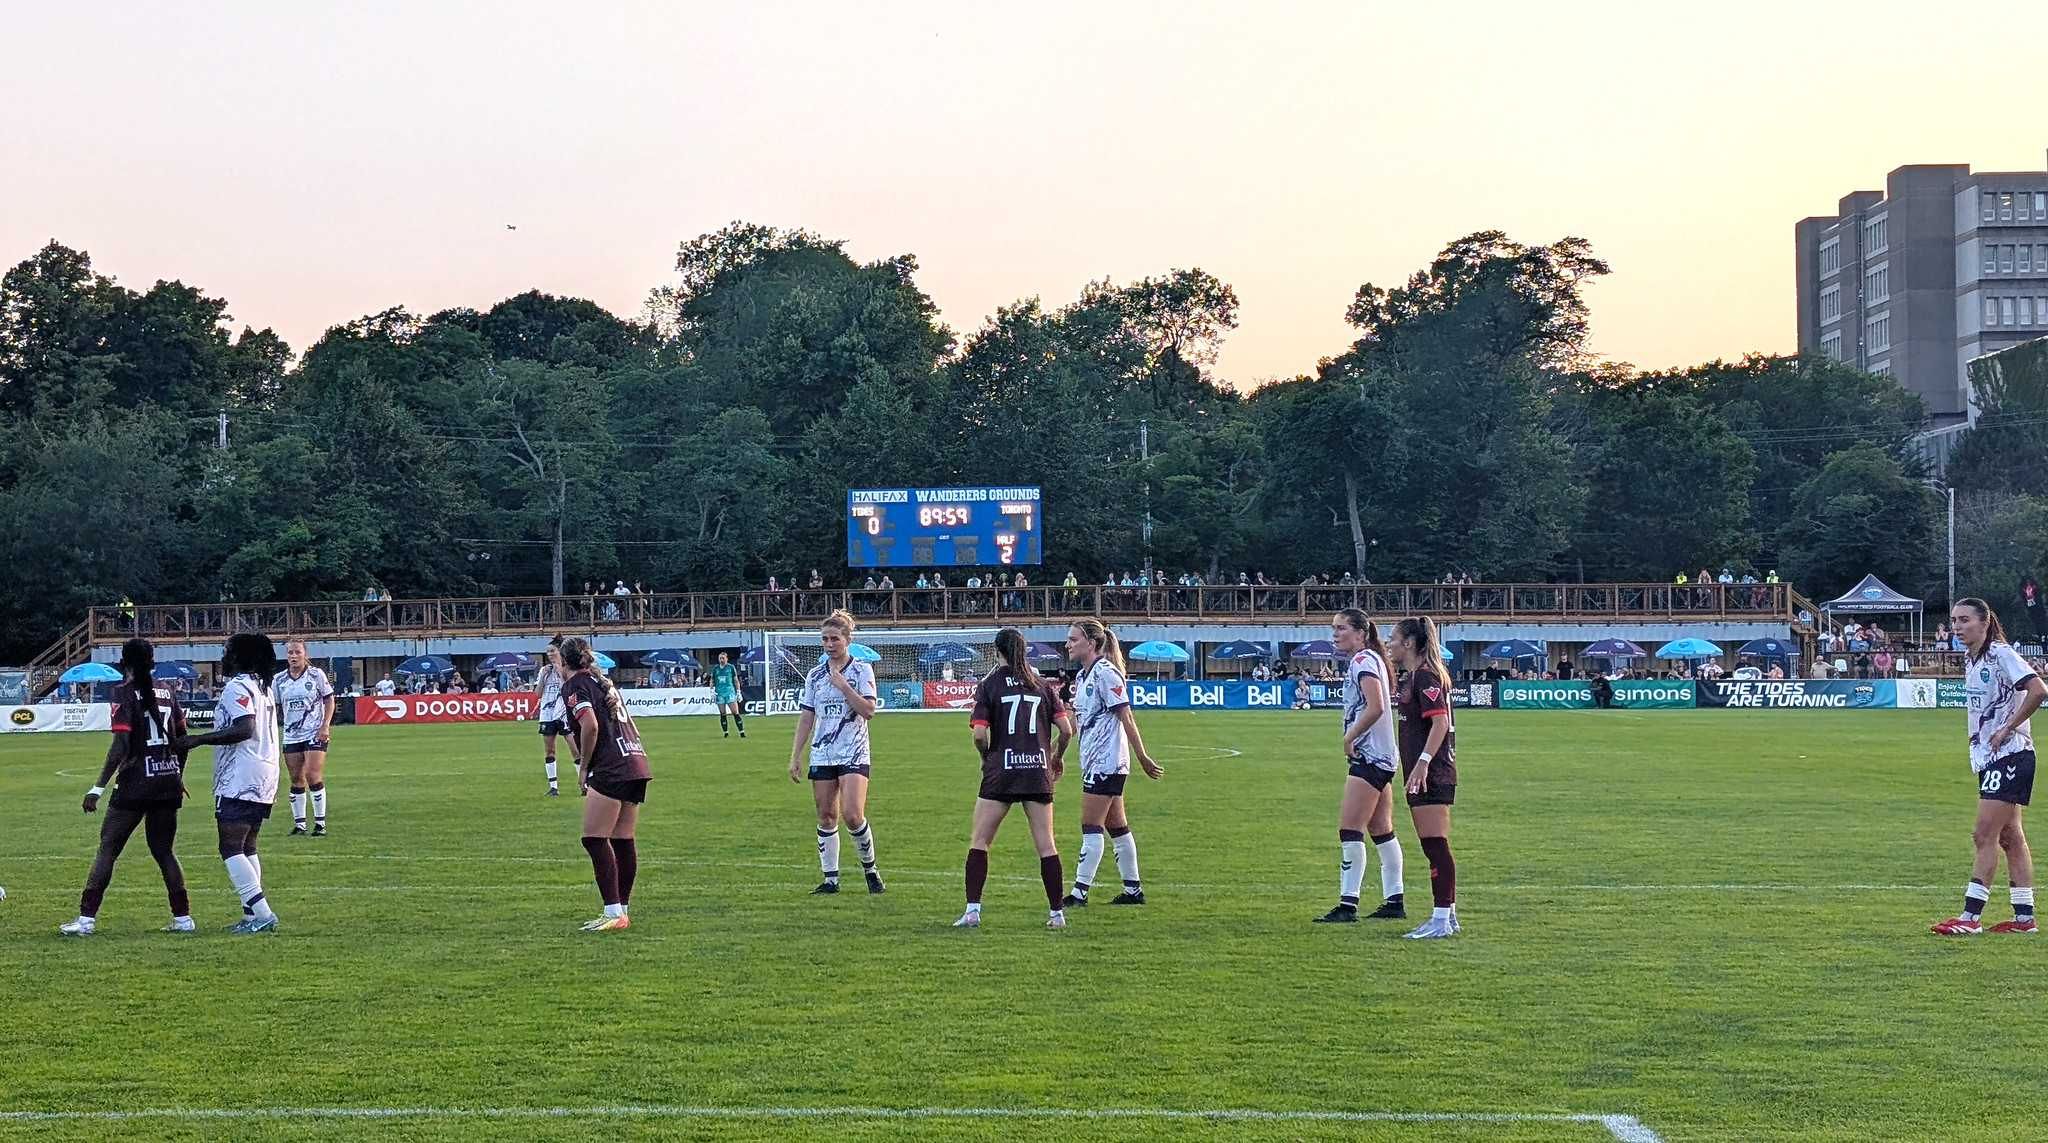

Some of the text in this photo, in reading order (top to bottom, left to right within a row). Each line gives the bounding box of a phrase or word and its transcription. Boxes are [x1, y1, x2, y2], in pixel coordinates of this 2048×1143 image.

[853, 492, 906, 502] HALIFAX
[915, 488, 1040, 502] WANDERERS GROUNDS
[851, 507, 874, 517] TIDES
[920, 507, 968, 526] 89:59
[1000, 504, 1032, 514] TORONTO
[868, 517, 880, 535] 0
[1025, 515, 1032, 531] 1
[996, 535, 1016, 545] HALF
[1001, 545, 1013, 564] 2
[1132, 685, 1167, 706] Bell
[1190, 685, 1224, 706] Bell
[1247, 685, 1282, 706] Bell
[1716, 682, 1805, 695] THE TIDES
[415, 698, 529, 716] DOORDASH
[625, 697, 667, 707] Autoport
[688, 696, 716, 706] Autop
[744, 700, 801, 712] GETTIN
[1726, 694, 1847, 707] ARE TURNING
[13, 712, 32, 721] PCL
[1000, 694, 1041, 734] 77
[144, 705, 172, 746] 17
[1981, 770, 2002, 791] 28
